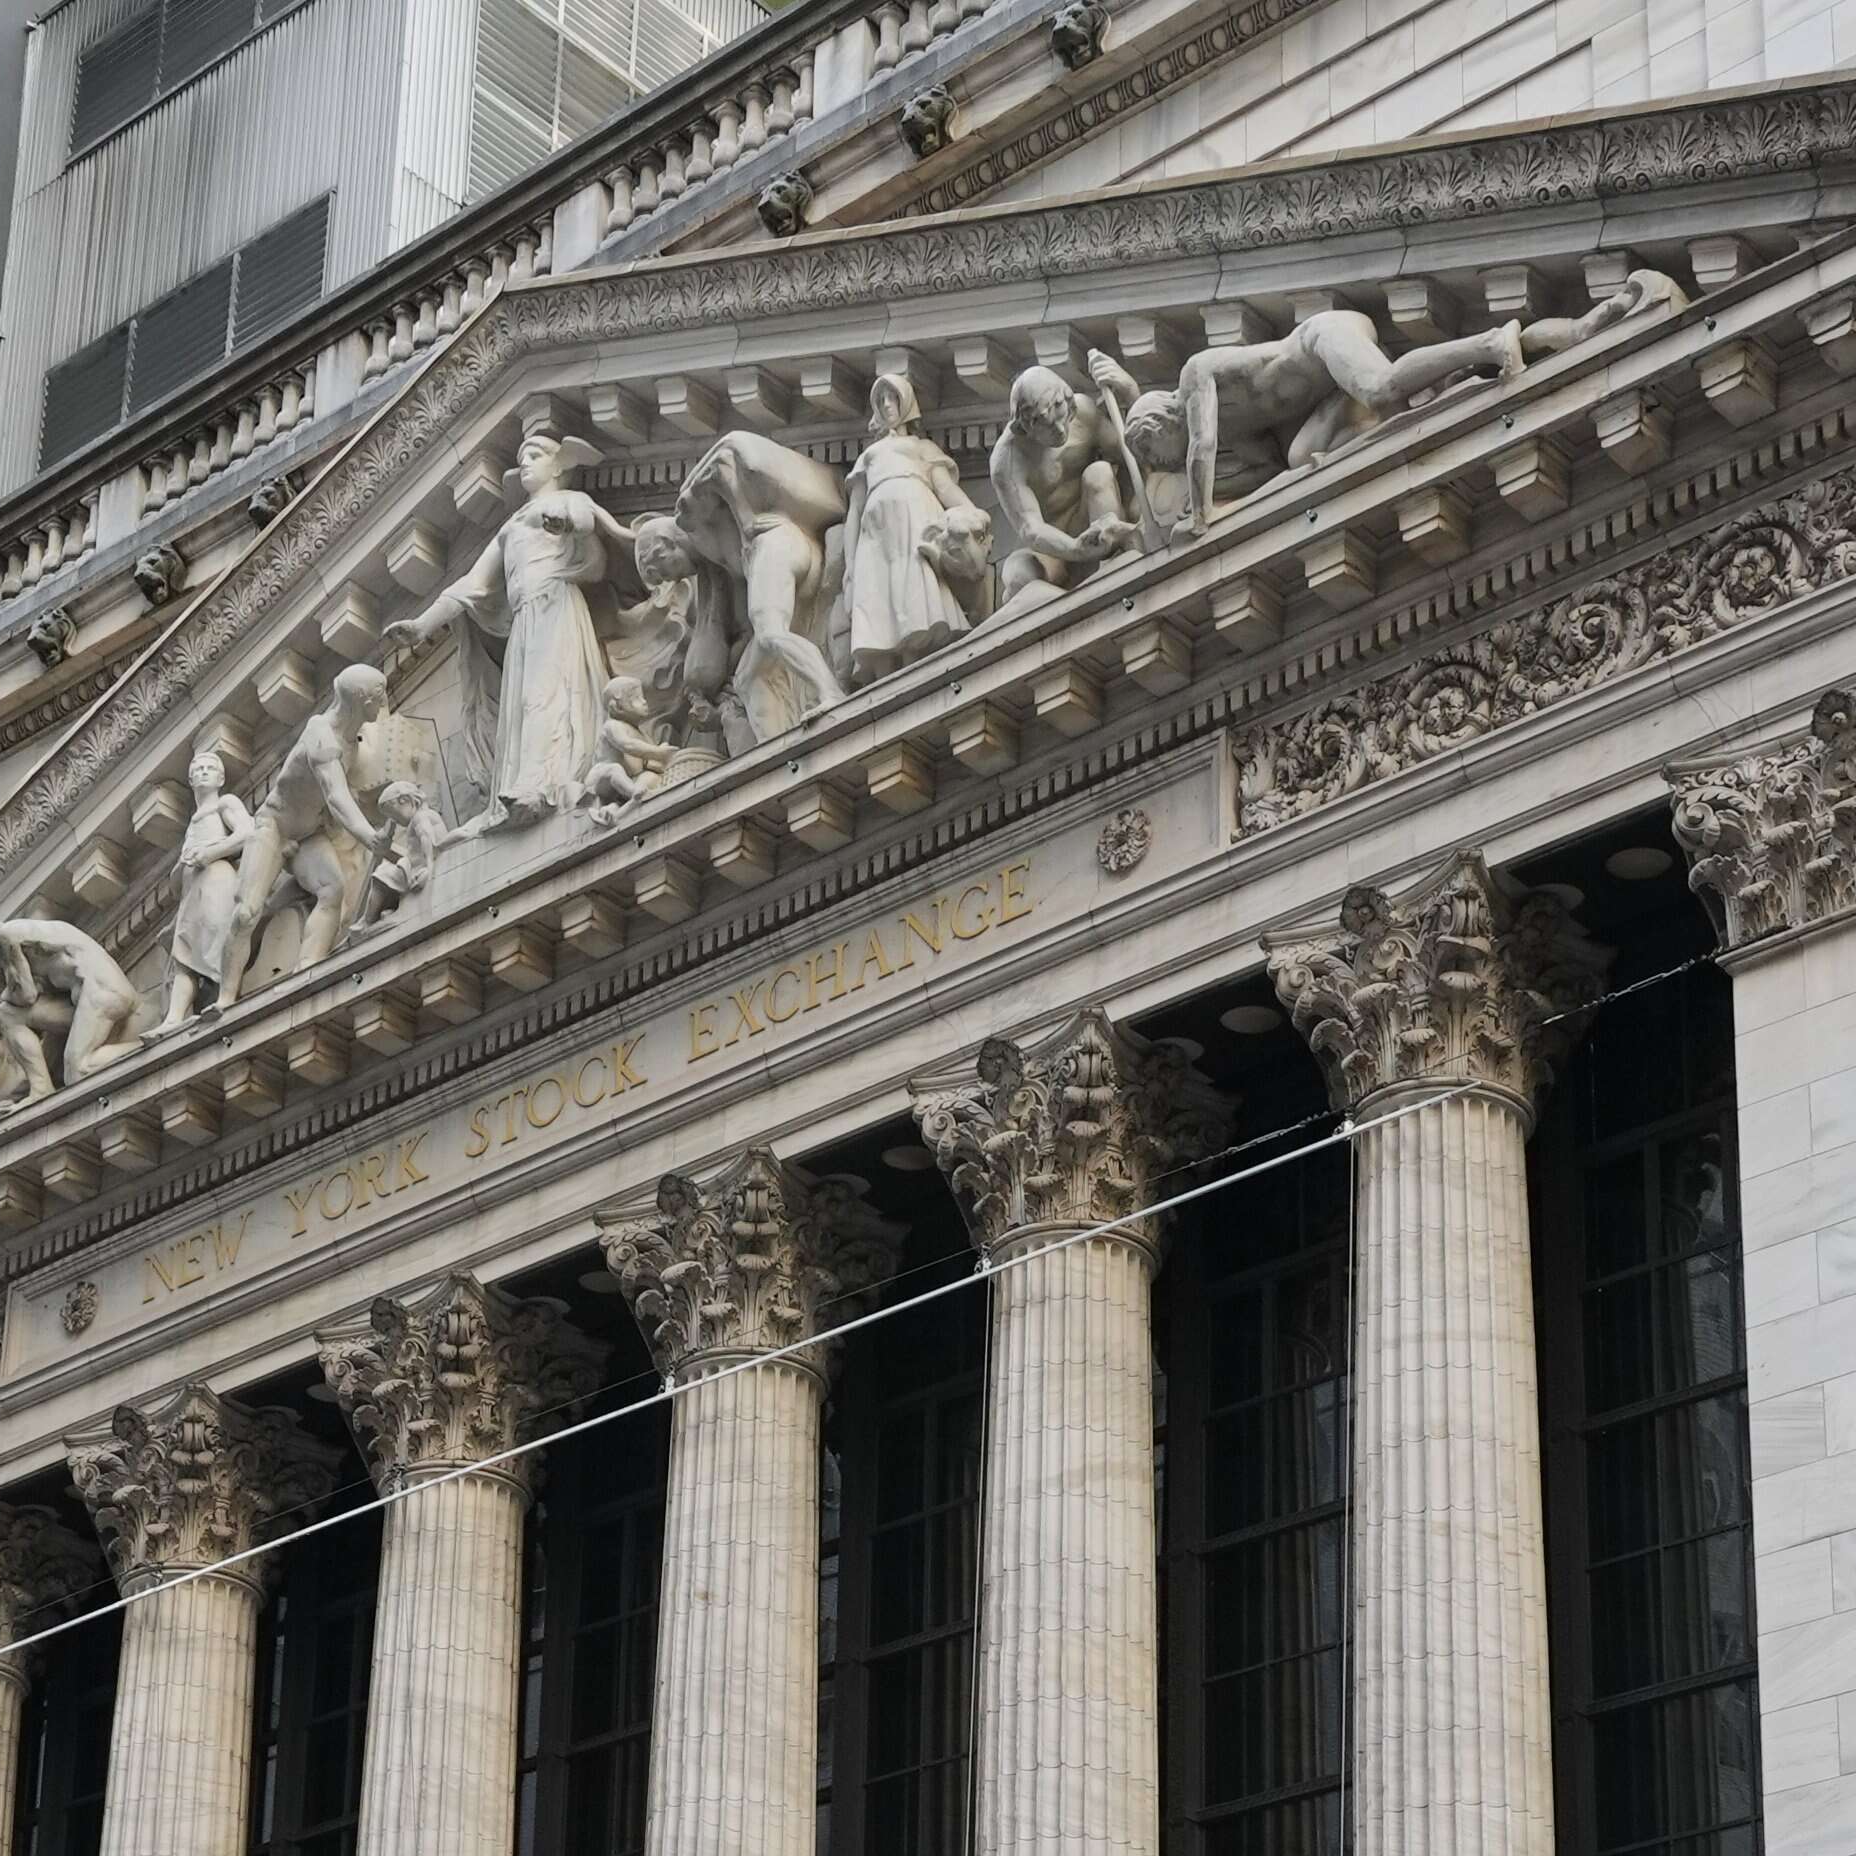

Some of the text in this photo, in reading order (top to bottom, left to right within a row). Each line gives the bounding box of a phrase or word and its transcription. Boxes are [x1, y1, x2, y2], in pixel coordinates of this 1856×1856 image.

[142, 857, 1036, 1305] NEW YORK STOCK EXCHANGE
